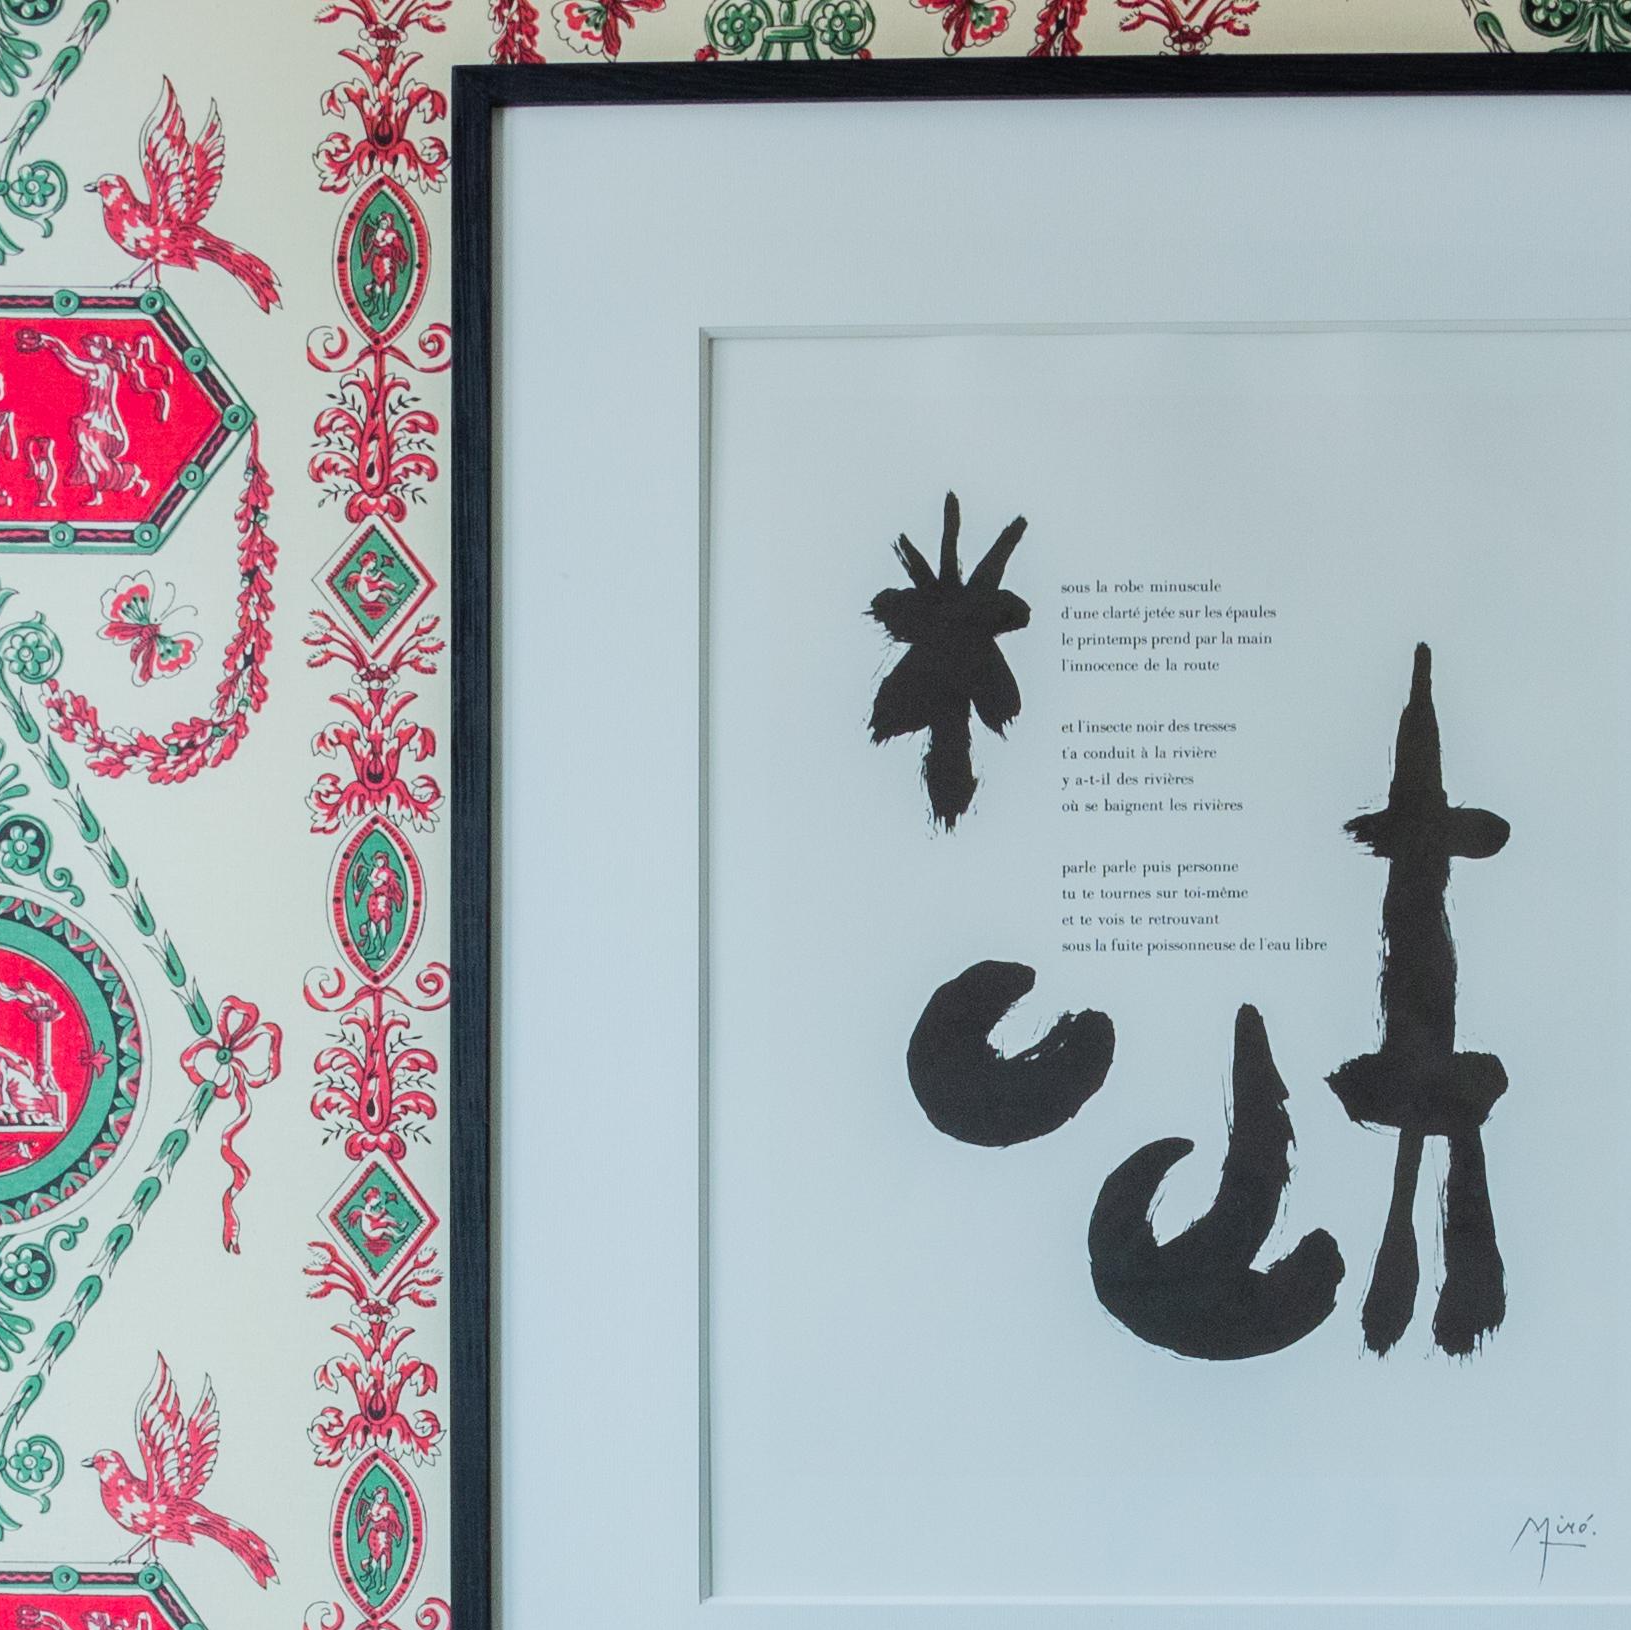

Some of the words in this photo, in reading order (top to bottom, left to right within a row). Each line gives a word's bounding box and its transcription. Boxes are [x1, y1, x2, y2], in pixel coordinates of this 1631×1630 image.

[1060, 583, 1091, 594] sous
[1096, 578, 1108, 593] la
[1114, 578, 1144, 593] robe
[1149, 578, 1222, 593] minuscule
[1060, 605, 1100, 620] d'une
[1102, 605, 1141, 620] clarté
[1142, 605, 1176, 624] jetée
[1178, 609, 1202, 619] sur
[1204, 604, 1223, 619] les
[1225, 603, 1277, 624] épaules
[1061, 631, 1074, 647] le
[1077, 633, 1148, 651] printemps
[1151, 631, 1191, 651] prend
[1195, 635, 1218, 650] par
[1220, 630, 1234, 646] la
[1237, 631, 1273, 646] main
[1061, 658, 1139, 673] l'innocence
[1143, 657, 1160, 672] de
[1165, 656, 1178, 672] la
[1183, 660, 1220, 672] route
[1061, 722, 1075, 734] et
[1077, 719, 1133, 734] l'insecte
[1136, 719, 1165, 733] noir
[1167, 718, 1191, 733] des
[1193, 721, 1238, 733] tresses
[1061, 746, 1078, 760] t'a
[1083, 745, 1136, 760] conduit
[1140, 746, 1149, 759] à
[1154, 744, 1167, 760] la
[1172, 745, 1218, 759] rivière
[1060, 776, 1070, 792] y
[1075, 771, 1111, 786] a-t-il
[1116, 771, 1139, 786] des
[1144, 772, 1195, 786] rivières
[1061, 799, 1079, 813] où
[1084, 802, 1099, 813] se
[1103, 797, 1164, 817] baignent
[1169, 797, 1188, 812] les
[1193, 798, 1244, 812] rivières
[1062, 859, 1097, 879] parle
[1102, 859, 1137, 879] parle
[1142, 860, 1172, 879] puis
[1177, 863, 1239, 878] personne
[1061, 889, 1076, 900] tu
[1082, 888, 1095, 900] te
[1100, 888, 1152, 900] tournes
[1156, 889, 1179, 900] sur
[1183, 886, 1249, 899] toi-même
[1061, 915, 1075, 927] et
[1079, 915, 1093, 927] te
[1097, 912, 1126, 926] vois
[1130, 914, 1143, 926] te
[1148, 913, 1219, 926] retrouvant
[1061, 942, 1092, 953] sous
[1095, 937, 1107, 952] la
[1111, 937, 1144, 952] fuite
[1146, 938, 1237, 957] poissonneuse
[1239, 936, 1256, 952] de
[1259, 936, 1291, 952] l'eau
[1295, 936, 1328, 952] libre
